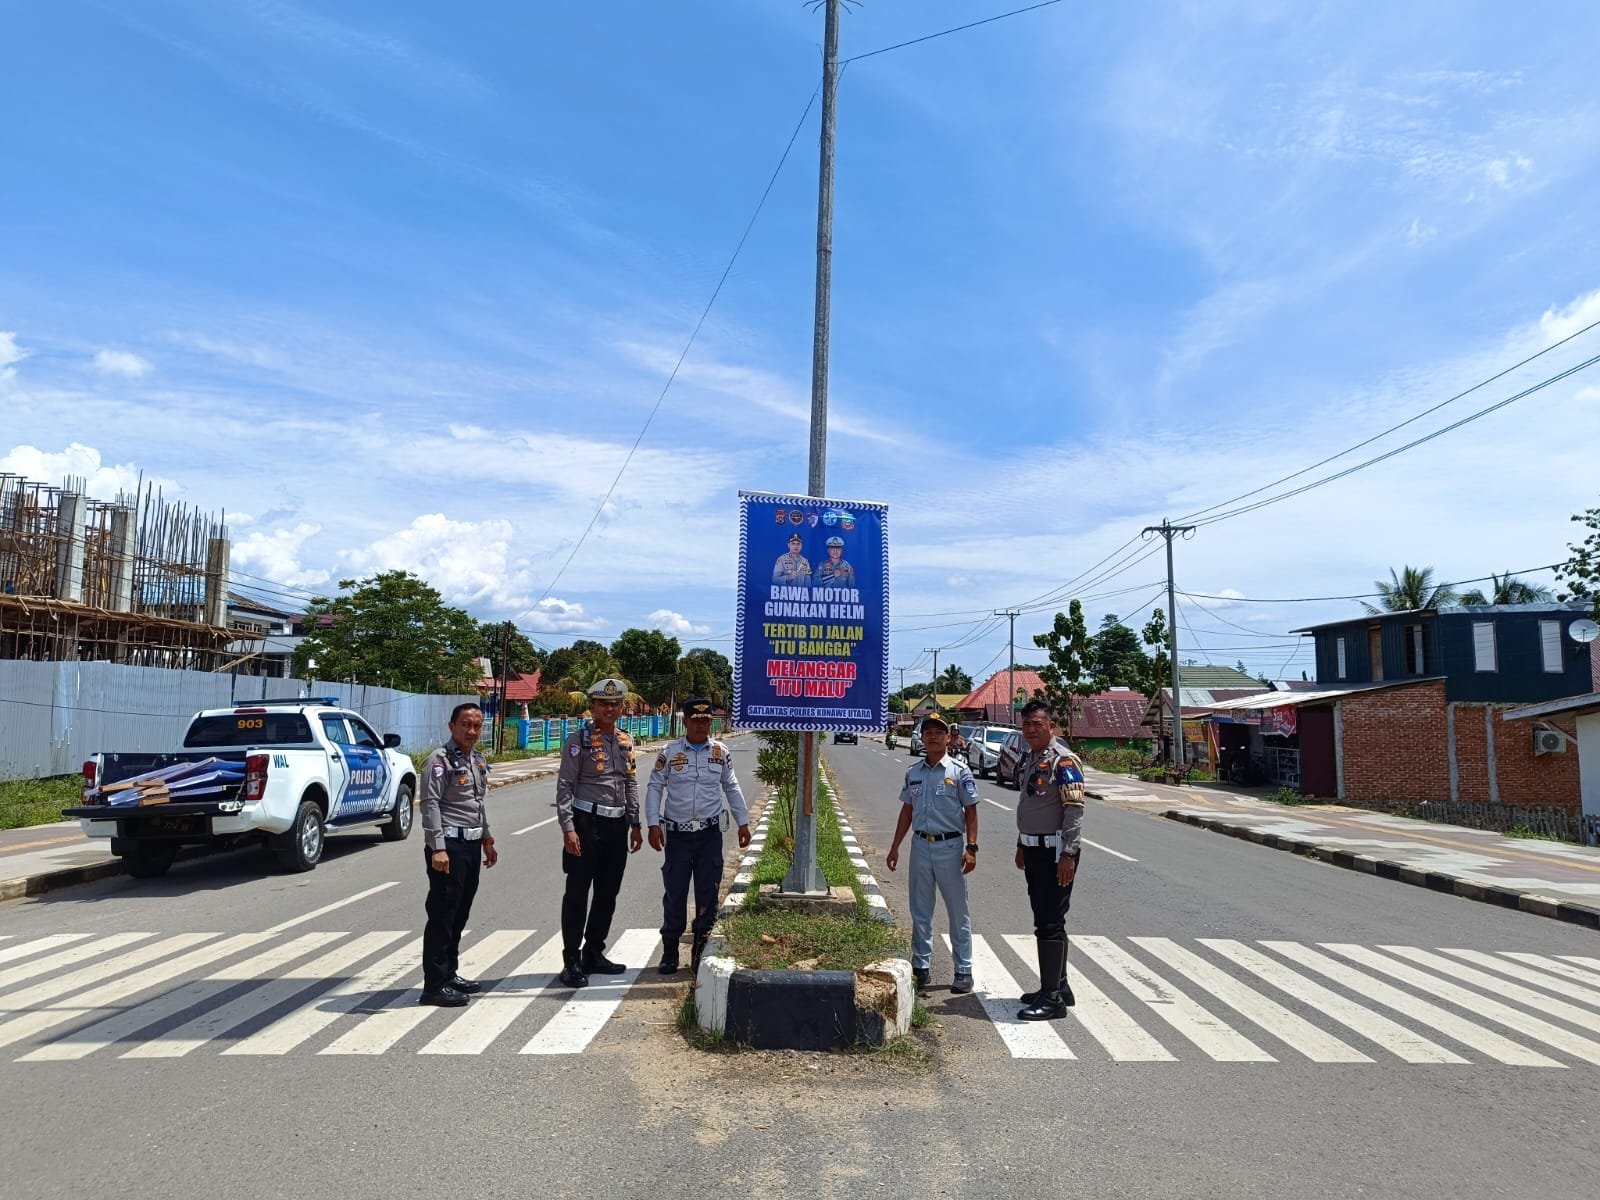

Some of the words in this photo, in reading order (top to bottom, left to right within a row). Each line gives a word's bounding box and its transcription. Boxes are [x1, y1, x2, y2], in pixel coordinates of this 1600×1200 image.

[770, 585, 810, 602] BAWA
[812, 587, 860, 603] MOTOR
[764, 601, 827, 618] GUNAKAN
[830, 604, 864, 619] HELM
[762, 623, 807, 639] TERTIB
[809, 624, 823, 639] DI
[826, 625, 863, 640] JALAN
[767, 660, 856, 680] MELANGGAR
[748, 705, 788, 716] SATLANTAS
[788, 707, 815, 718] POLRES
[815, 708, 848, 719] KONAWE
[847, 709, 873, 720] UTARA
[238, 719, 263, 729] 903
[273, 754, 289, 768] WAL
[351, 769, 374, 785] POLISI
